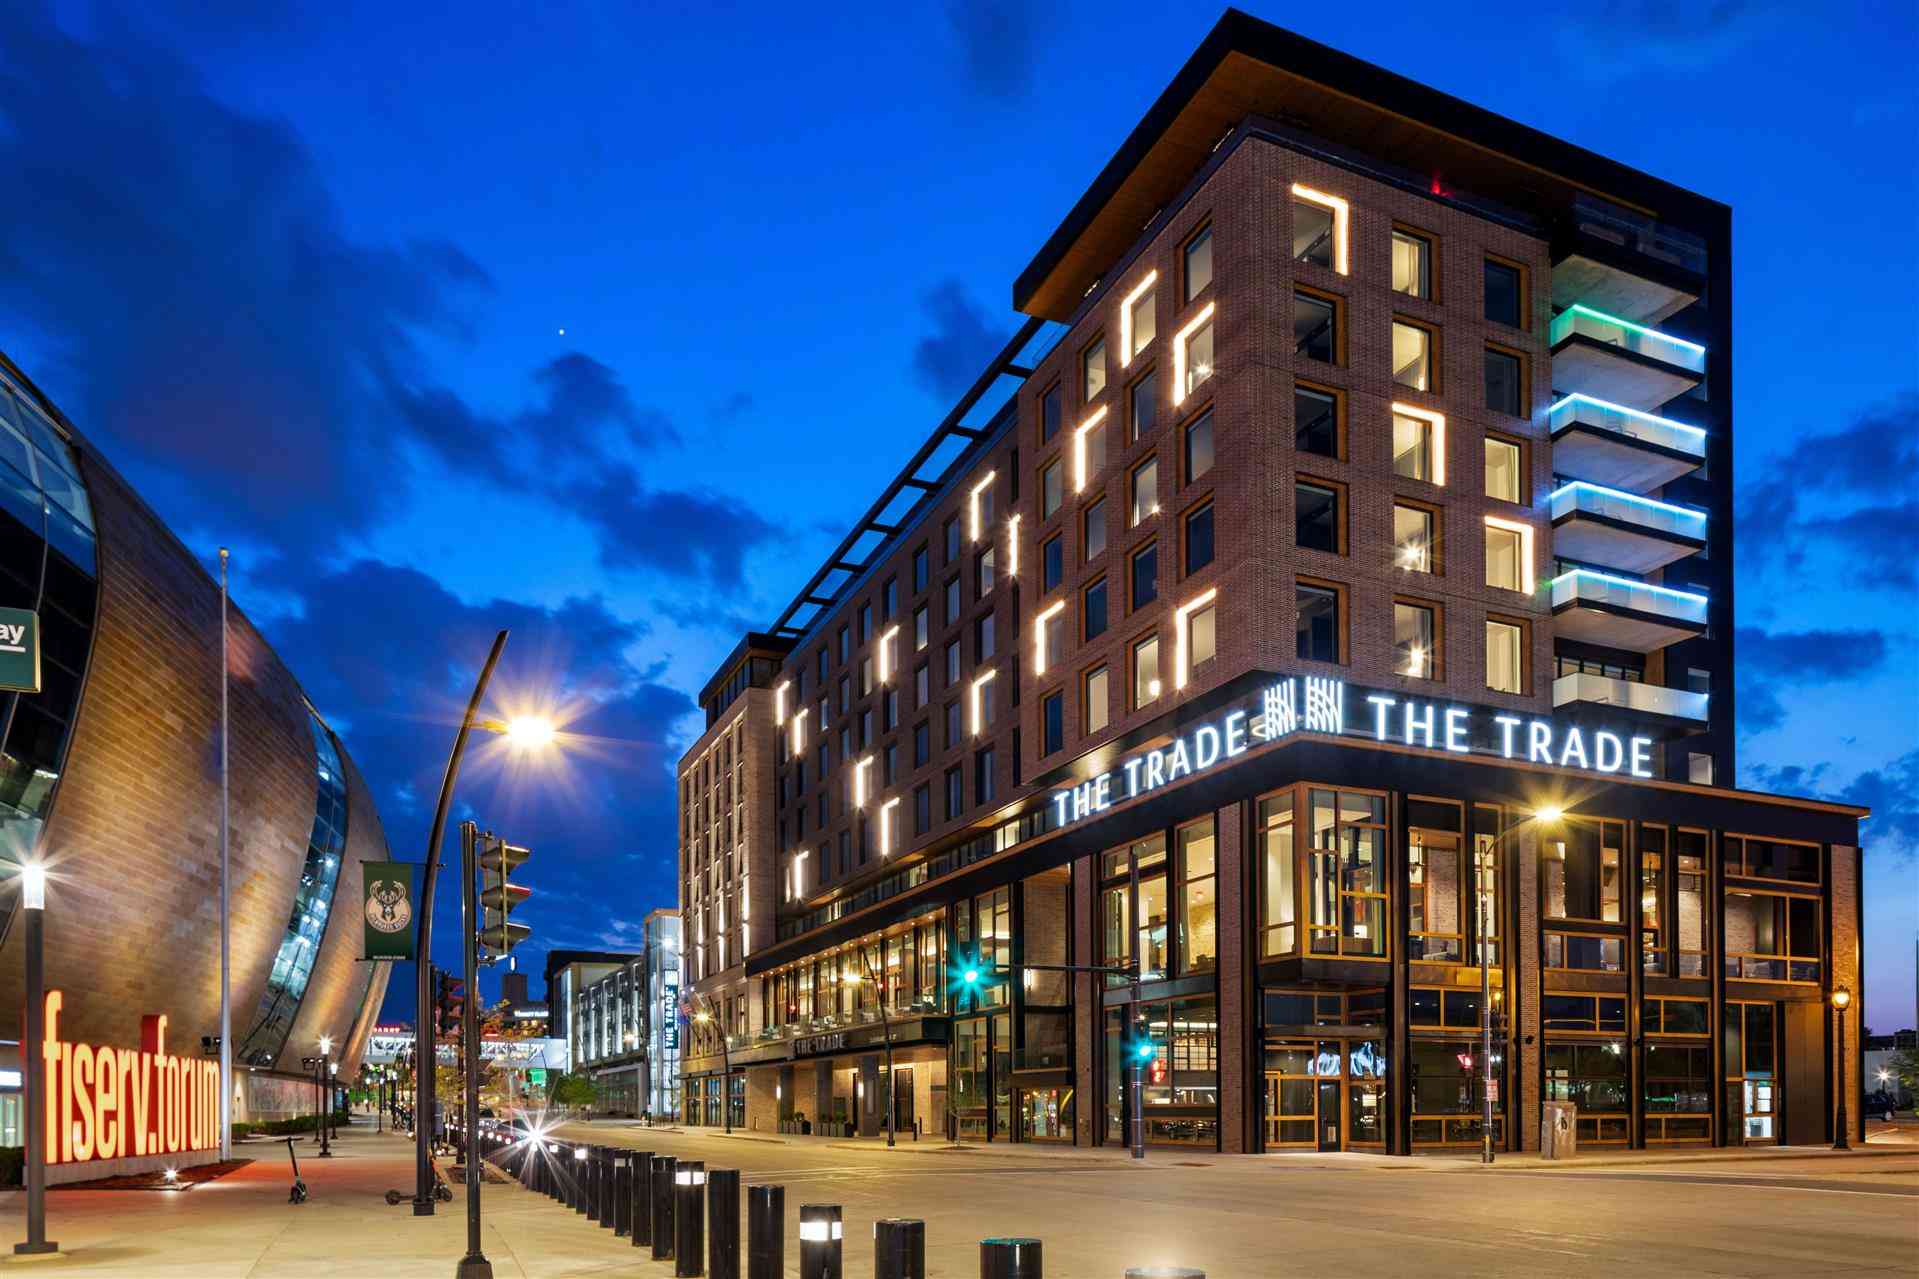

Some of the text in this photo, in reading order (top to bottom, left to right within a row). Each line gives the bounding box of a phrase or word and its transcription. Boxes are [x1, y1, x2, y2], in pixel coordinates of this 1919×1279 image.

[1054, 710, 1249, 827] THE TRADE
[1367, 695, 1653, 778] THE TRADE
[665, 988, 674, 1048] THE TRADE
[796, 1033, 846, 1056] THE TRADE
